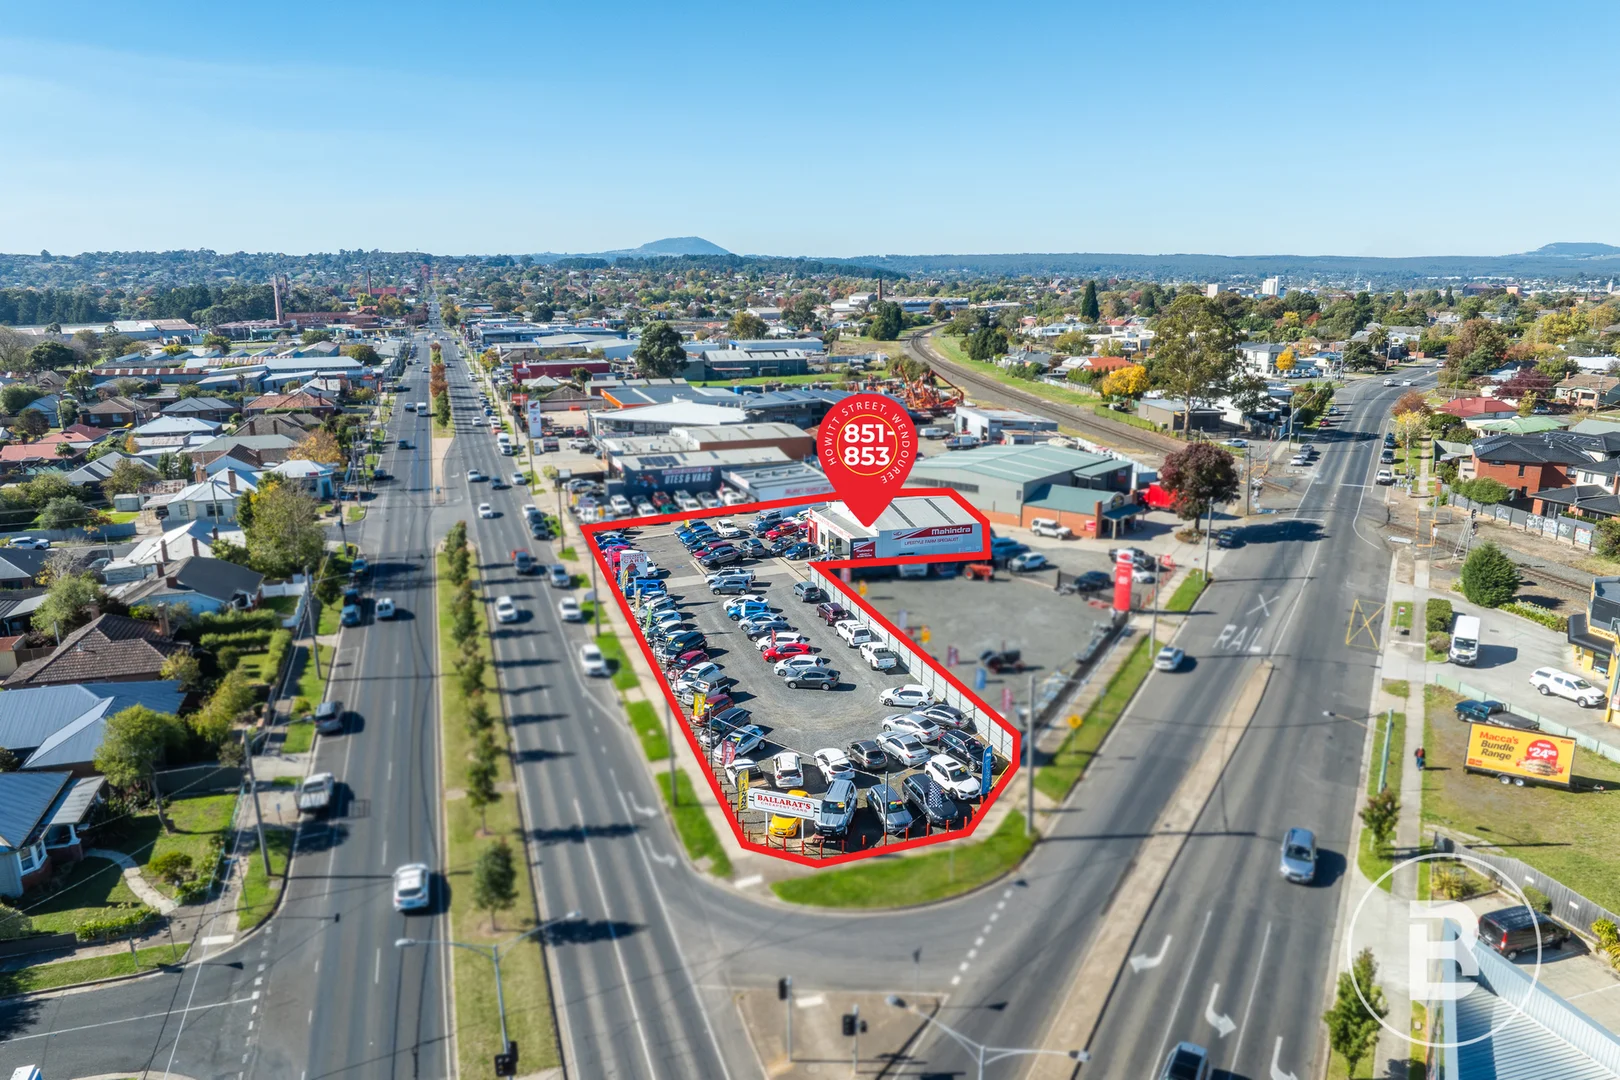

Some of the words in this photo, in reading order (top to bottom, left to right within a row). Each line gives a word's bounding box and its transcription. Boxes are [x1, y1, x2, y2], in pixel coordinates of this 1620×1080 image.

[665, 473, 684, 484] UTES
[692, 472, 712, 482] VANS
[931, 527, 971, 535] Mahindra
[1212, 624, 1262, 652] RAIL
[1479, 731, 1519, 745] Macca's
[1481, 740, 1515, 753] Bundle
[1481, 748, 1512, 761] Range
[757, 794, 811, 809] BALLARAT'S
